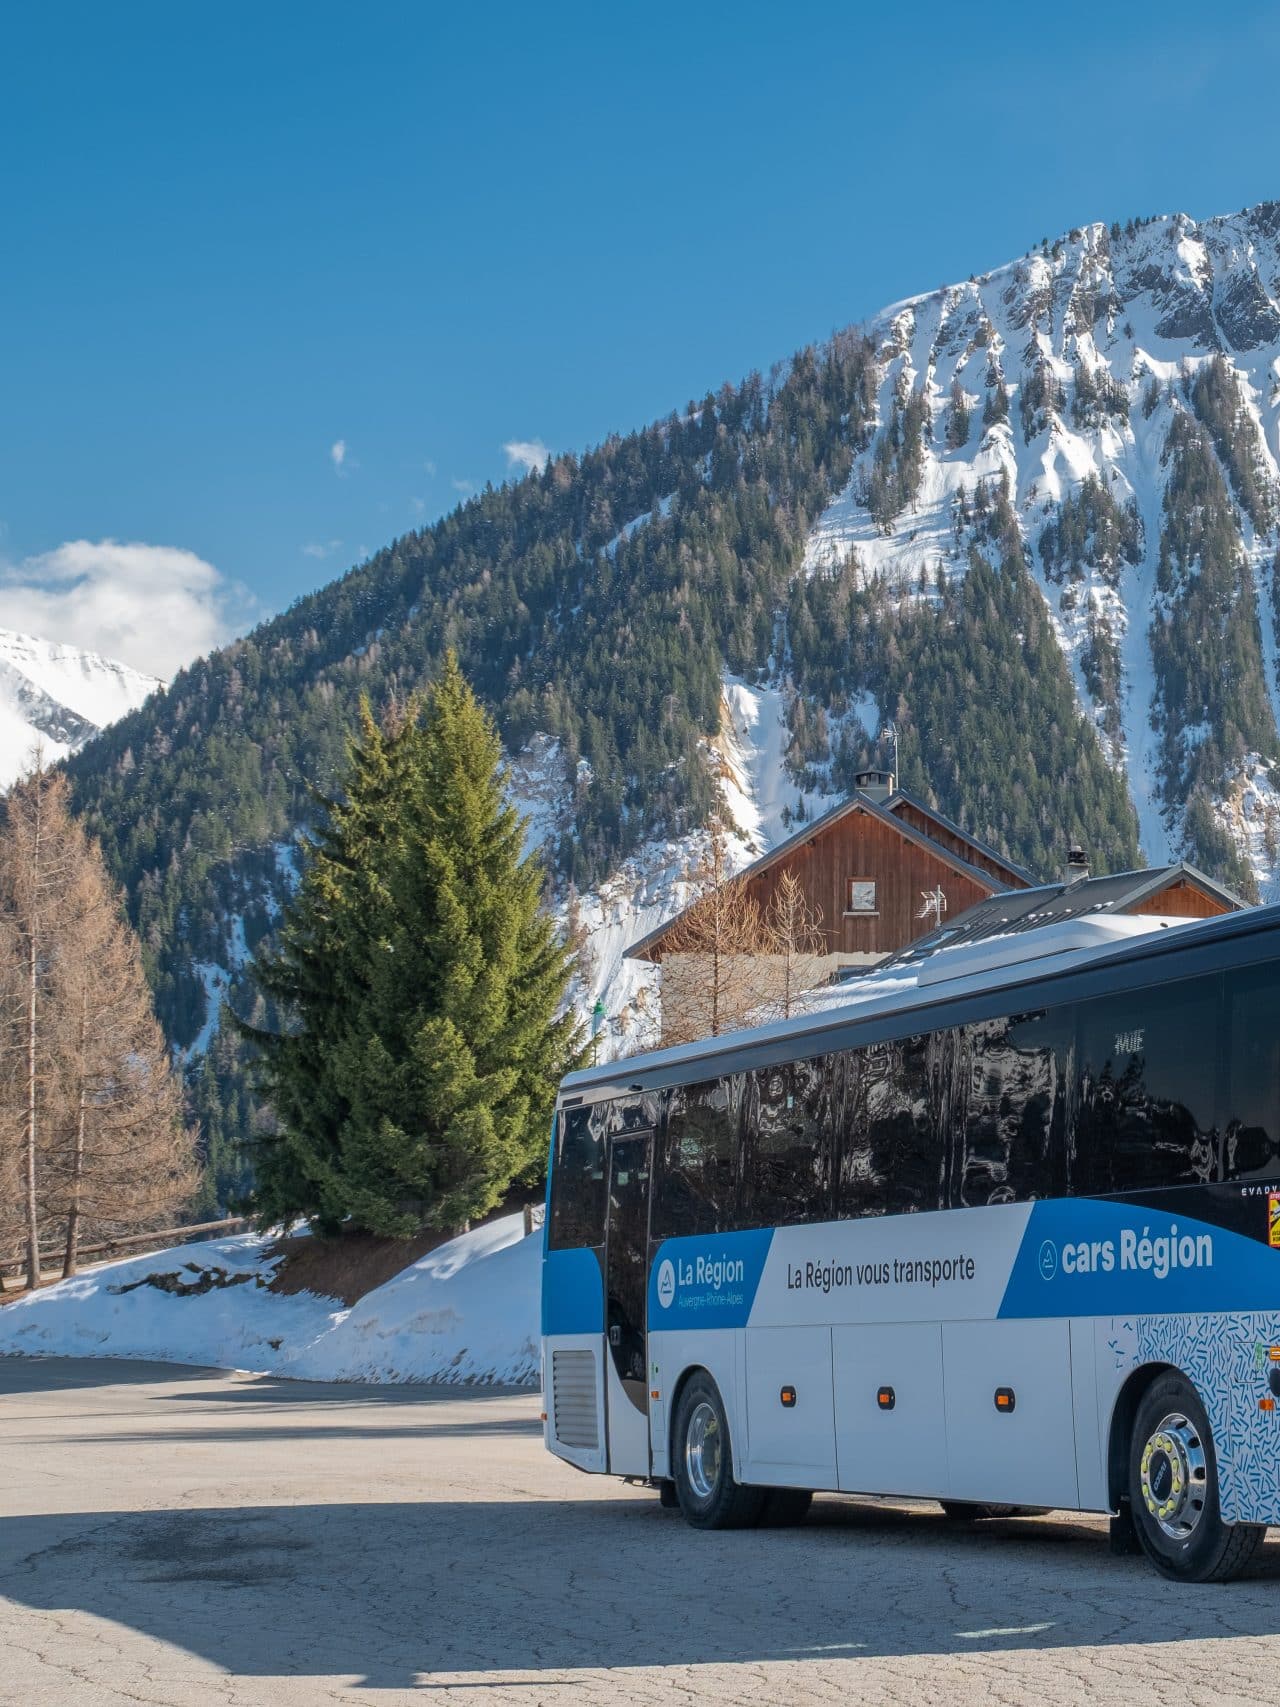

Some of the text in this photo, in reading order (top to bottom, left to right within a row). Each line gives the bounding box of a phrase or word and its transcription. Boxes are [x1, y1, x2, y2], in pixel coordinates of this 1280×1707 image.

[1062, 1223, 1214, 1279] cars Région
[678, 1253, 744, 1290] La Région
[787, 1254, 976, 1294] La Région vous transporte
